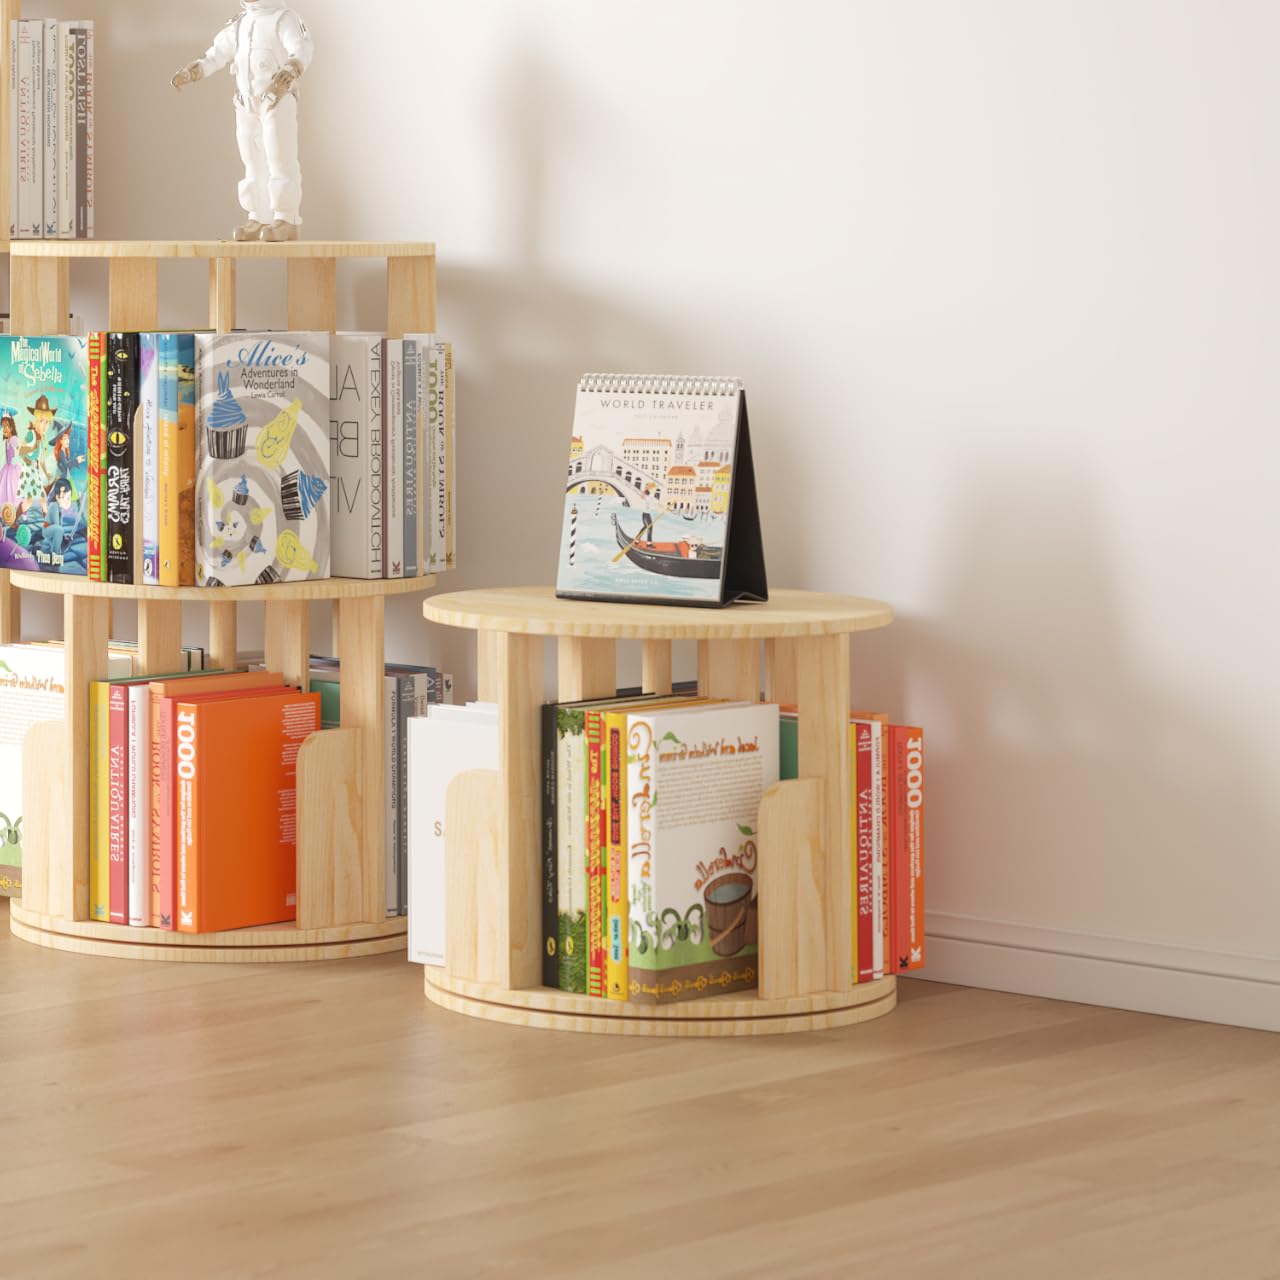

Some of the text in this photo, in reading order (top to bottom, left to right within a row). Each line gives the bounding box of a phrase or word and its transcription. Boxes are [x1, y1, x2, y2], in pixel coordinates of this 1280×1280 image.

[11, 341, 62, 366] Magical World
[227, 339, 309, 368] Alice's
[23, 363, 62, 388] Sebella
[240, 368, 298, 379] Adventures in
[243, 378, 295, 390] Wonderland
[600, 399, 714, 411] WORLD TRAVELER
